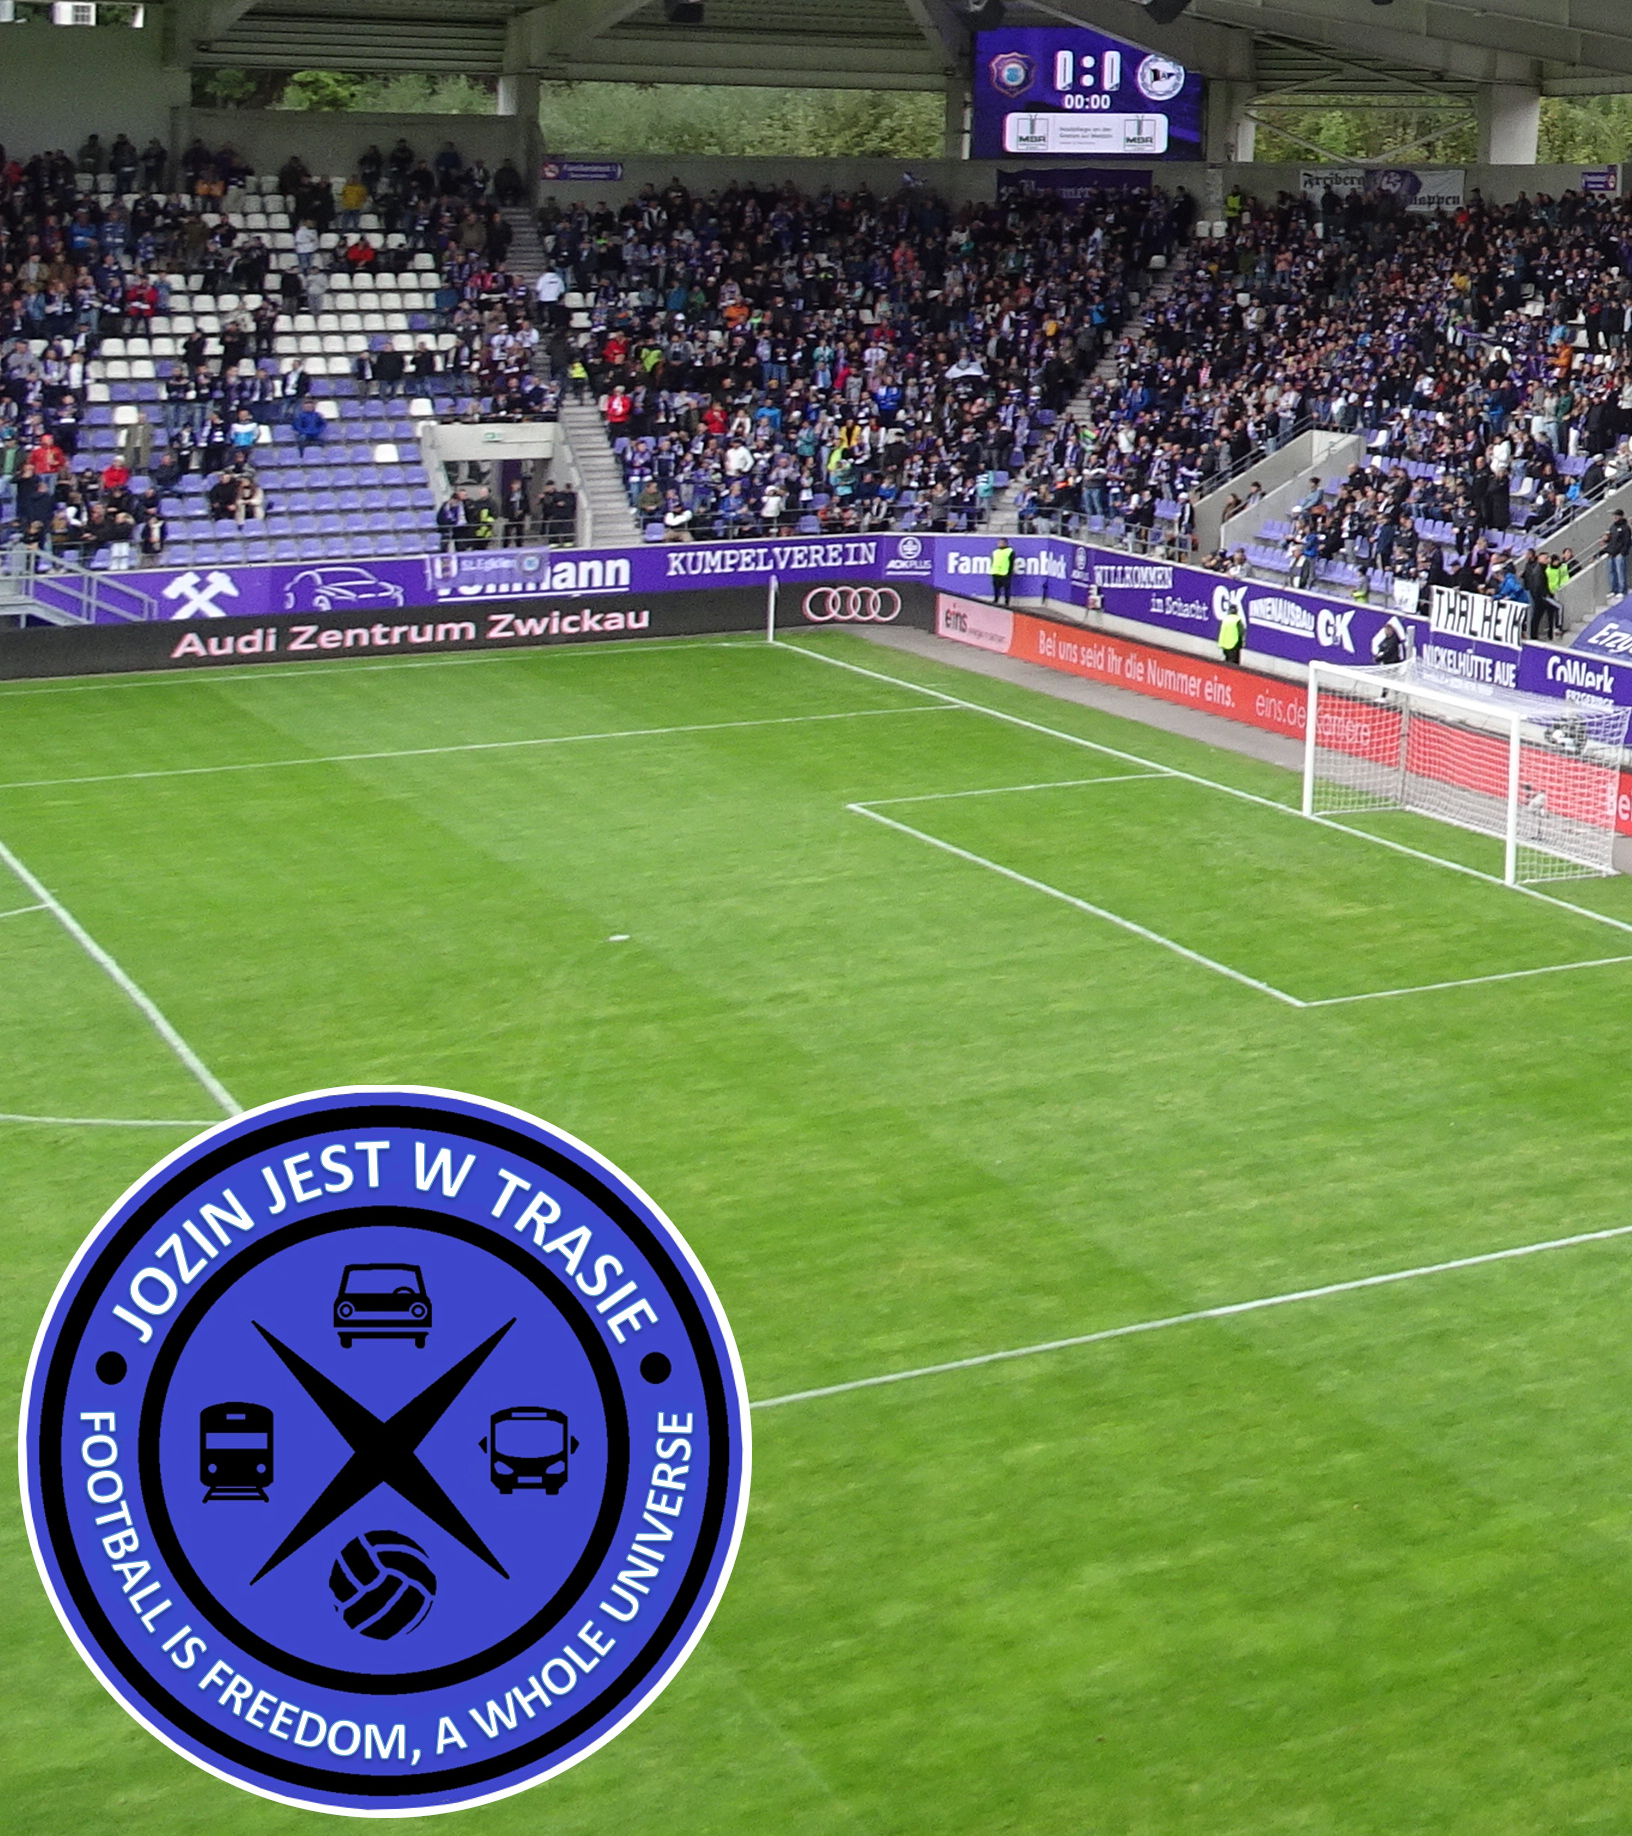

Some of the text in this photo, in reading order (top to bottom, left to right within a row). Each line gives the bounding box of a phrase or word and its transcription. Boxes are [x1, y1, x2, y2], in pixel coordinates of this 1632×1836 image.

[1064, 94, 1111, 109] 00:00
[667, 541, 878, 577] KUMPELVEREIN
[948, 551, 1066, 579] Famenblock
[1093, 565, 1173, 590] WILLKOMMEN
[1165, 596, 1209, 621] Schacht
[1250, 596, 1315, 632] INNENAUSBAU
[171, 609, 650, 659] Audi Zentrum Zwickau
[1038, 630, 1056, 656] Bei
[1059, 640, 1078, 663] uns
[1080, 645, 1104, 671] seid
[1107, 647, 1123, 674] ihr
[1125, 653, 1144, 682] die
[1147, 658, 1202, 698] Nummer
[1204, 675, 1236, 708] eins.
[1422, 644, 1493, 682] NICKELHÜTTE
[1494, 660, 1517, 688] AUE
